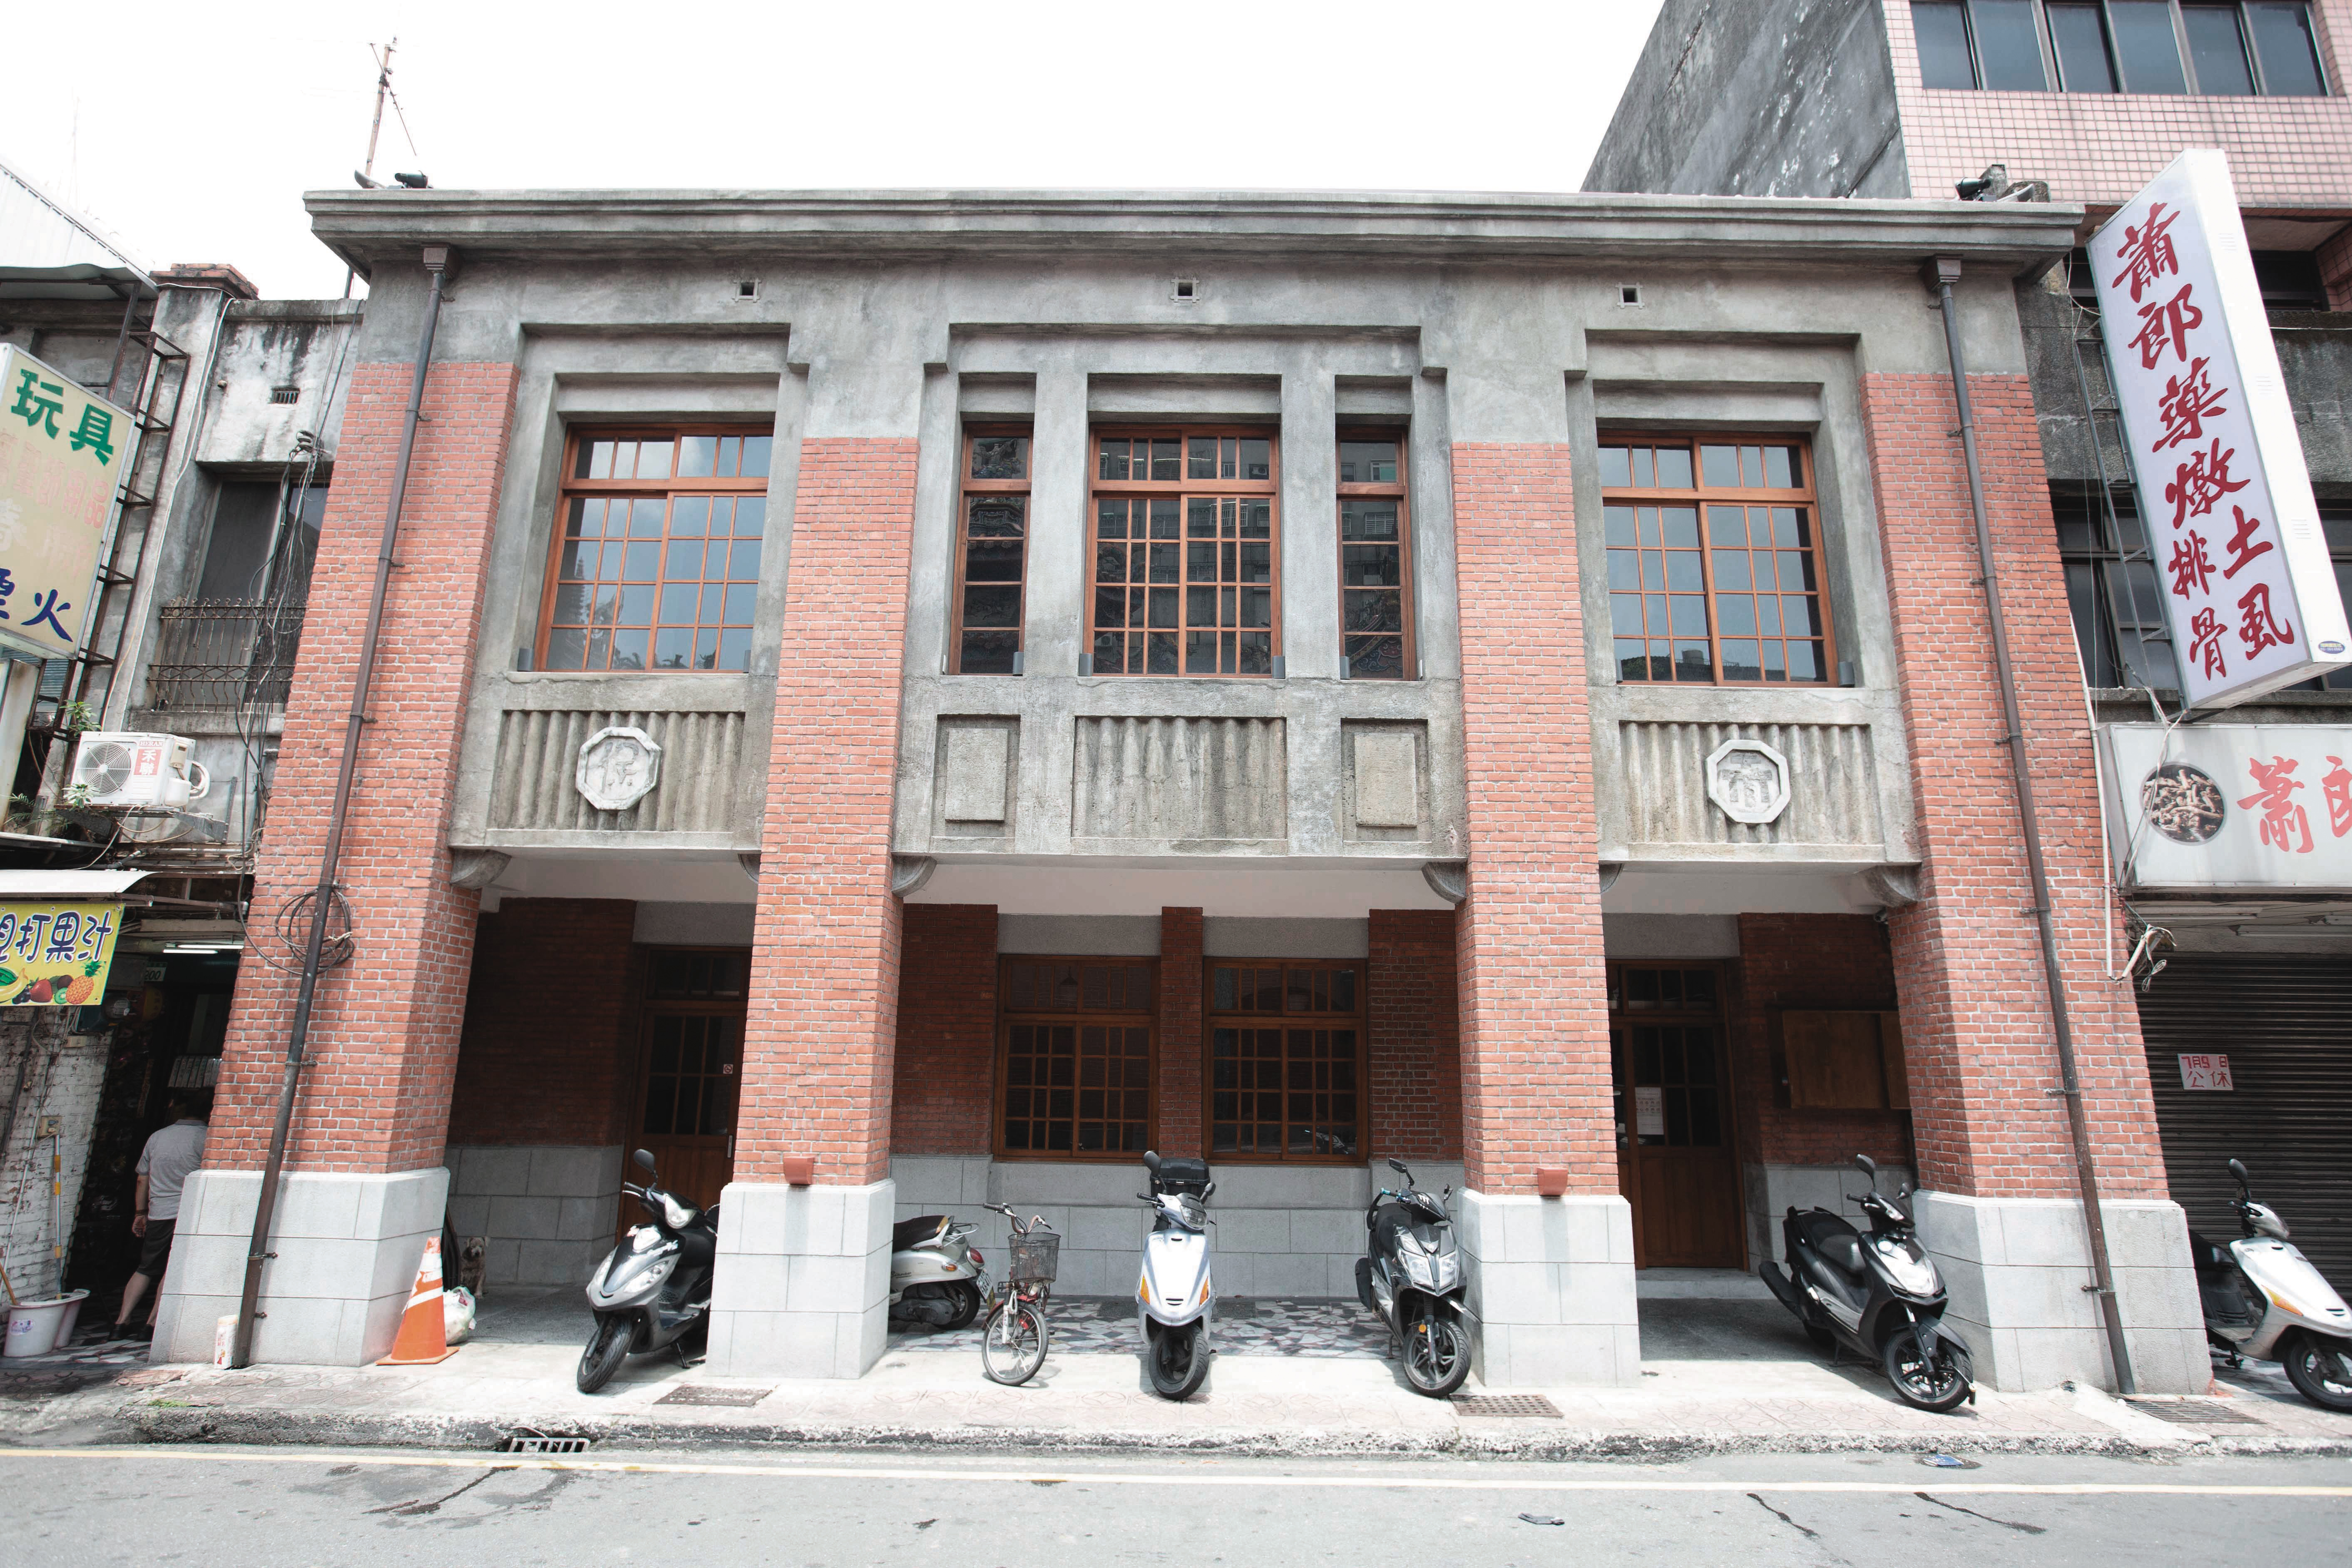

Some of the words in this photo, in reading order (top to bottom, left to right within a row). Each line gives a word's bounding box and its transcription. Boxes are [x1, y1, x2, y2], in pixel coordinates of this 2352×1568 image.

[10, 369, 114, 466] 玩具
[2168, 529, 2228, 681] 排骨
[139, 750, 157, 775] 禾聯
[2185, 1071, 2232, 1088] 公休
